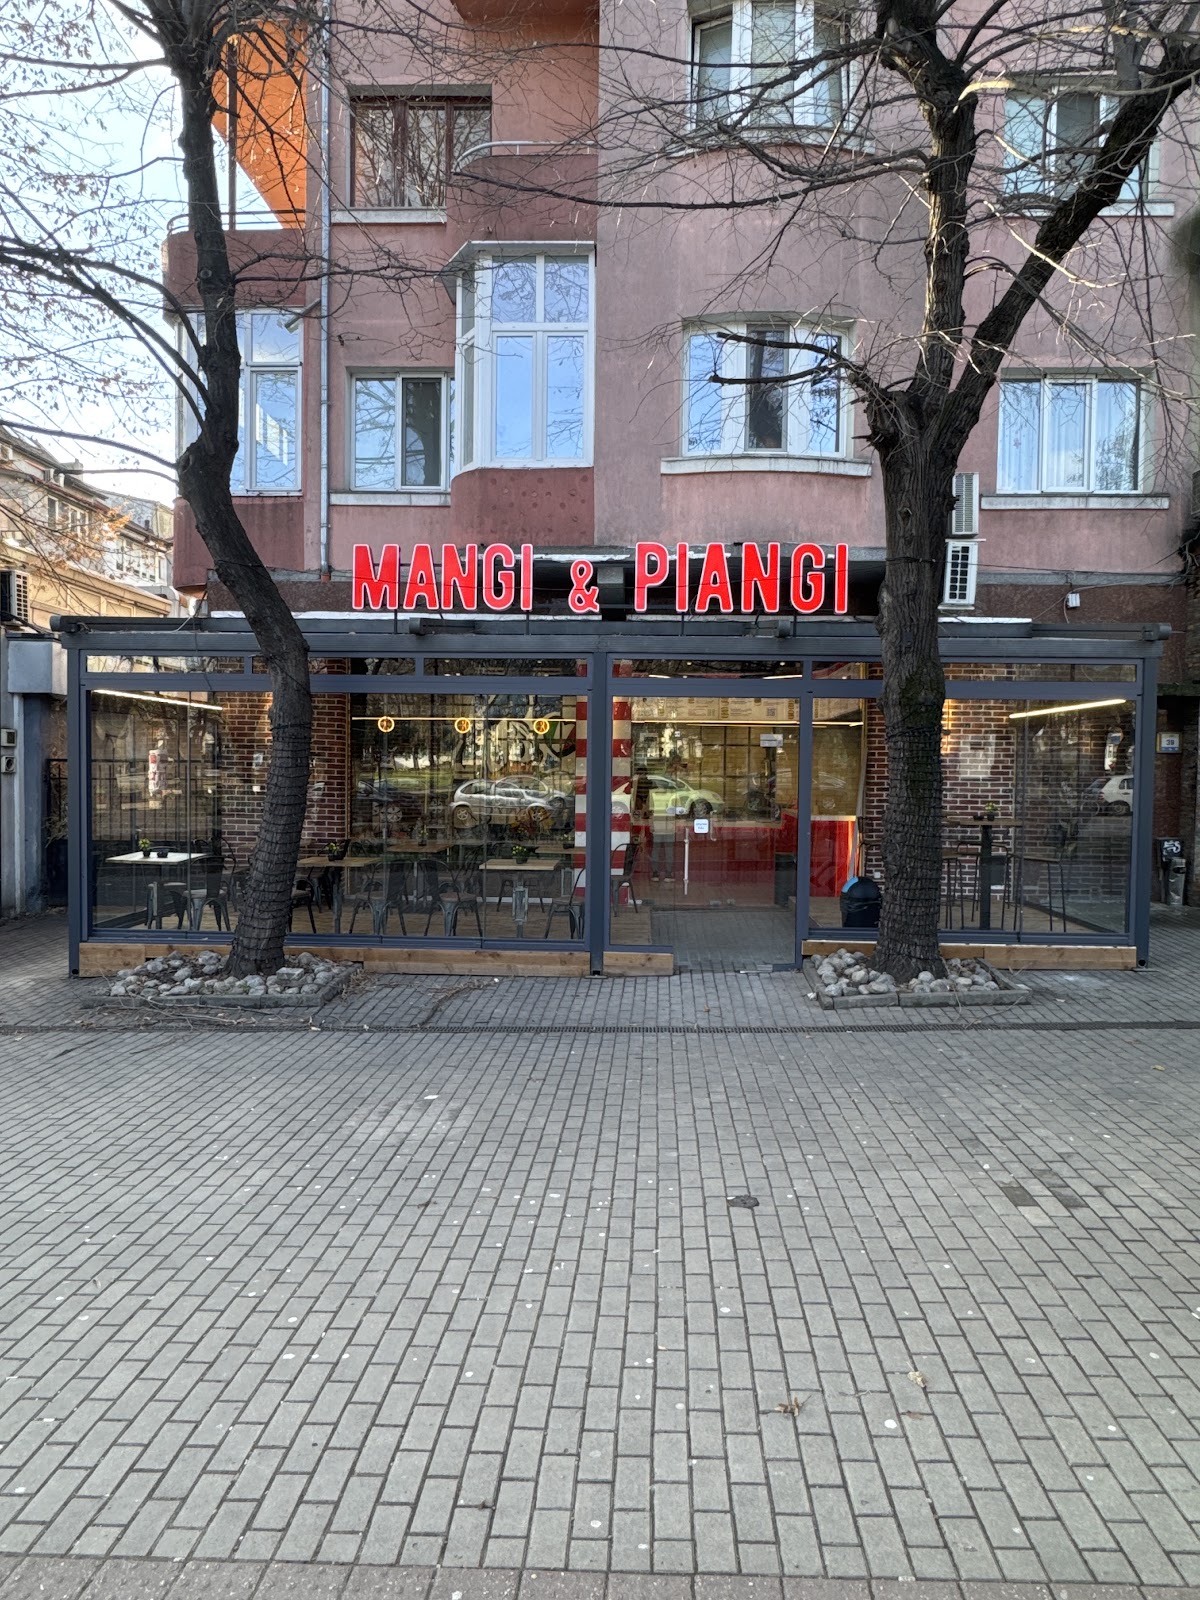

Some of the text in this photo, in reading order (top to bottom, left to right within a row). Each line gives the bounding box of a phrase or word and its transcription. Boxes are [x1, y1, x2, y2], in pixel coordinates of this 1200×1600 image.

[352, 541, 849, 614] MANGI & PIANGI
